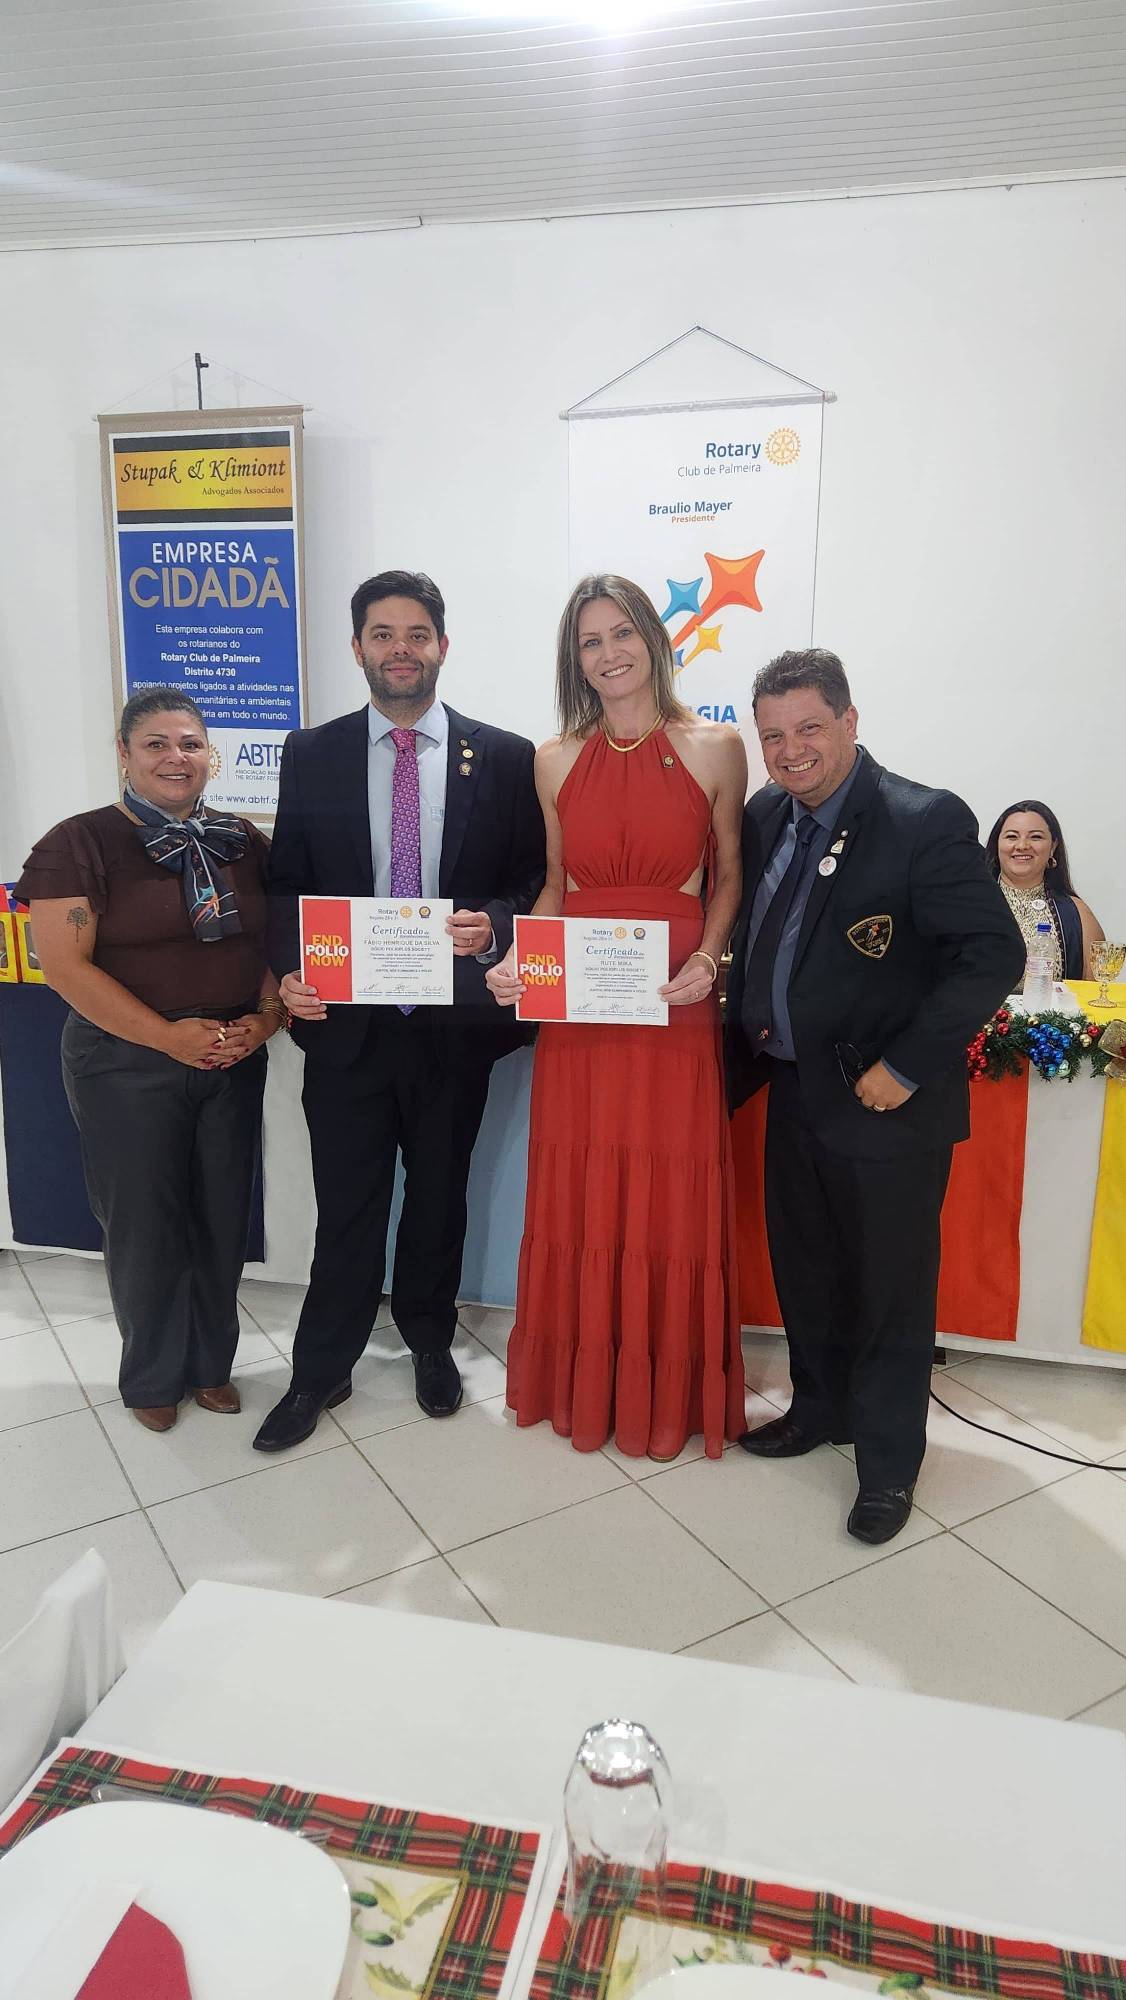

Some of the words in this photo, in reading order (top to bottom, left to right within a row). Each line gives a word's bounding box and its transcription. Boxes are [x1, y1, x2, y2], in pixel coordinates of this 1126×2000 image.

[705, 441, 762, 459] Rotary
[121, 459, 182, 486] Stupak
[187, 458, 205, 480] &
[209, 457, 286, 481] Klimiont
[678, 464, 701, 477] Club
[704, 464, 717, 476] de
[719, 462, 762, 476] Palmeira
[202, 487, 242, 497] Advogados
[243, 485, 285, 495] Associados
[648, 501, 691, 516] Braulio
[694, 499, 733, 515] Mayer
[671, 513, 716, 524] Presidente
[152, 541, 258, 564] EMPRESA
[128, 556, 290, 609] CIDADÃ
[155, 624, 173, 634] Esta
[174, 626, 208, 636] empresa
[209, 625, 244, 635] colabora
[245, 627, 264, 635] com
[189, 639, 228, 649] rotarianos
[229, 639, 241, 649] do
[160, 653, 188, 663] Rotary
[189, 653, 208, 663] Club
[209, 653, 221, 663] de
[222, 654, 261, 663] Palmeira
[184, 667, 214, 676] Distrito
[215, 667, 236, 677] 4730
[199, 681, 228, 692] ligados
[236, 682, 277, 692] atividades
[279, 684, 295, 692] nas
[239, 697, 246, 705] e
[247, 696, 292, 707] ambientais
[217, 711, 231, 719] em
[232, 709, 251, 719] todo
[209, 792, 224, 802] site
[378, 908, 399, 916] Rotary
[372, 925, 424, 939] Certificado
[592, 929, 613, 937] Rotary
[312, 934, 343, 946] END
[305, 944, 349, 957] POLIO
[586, 945, 638, 959] Certificado
[310, 955, 345, 967] NOW
[526, 953, 557, 965] END
[519, 963, 563, 977] POLIO
[524, 974, 560, 986] NOW
